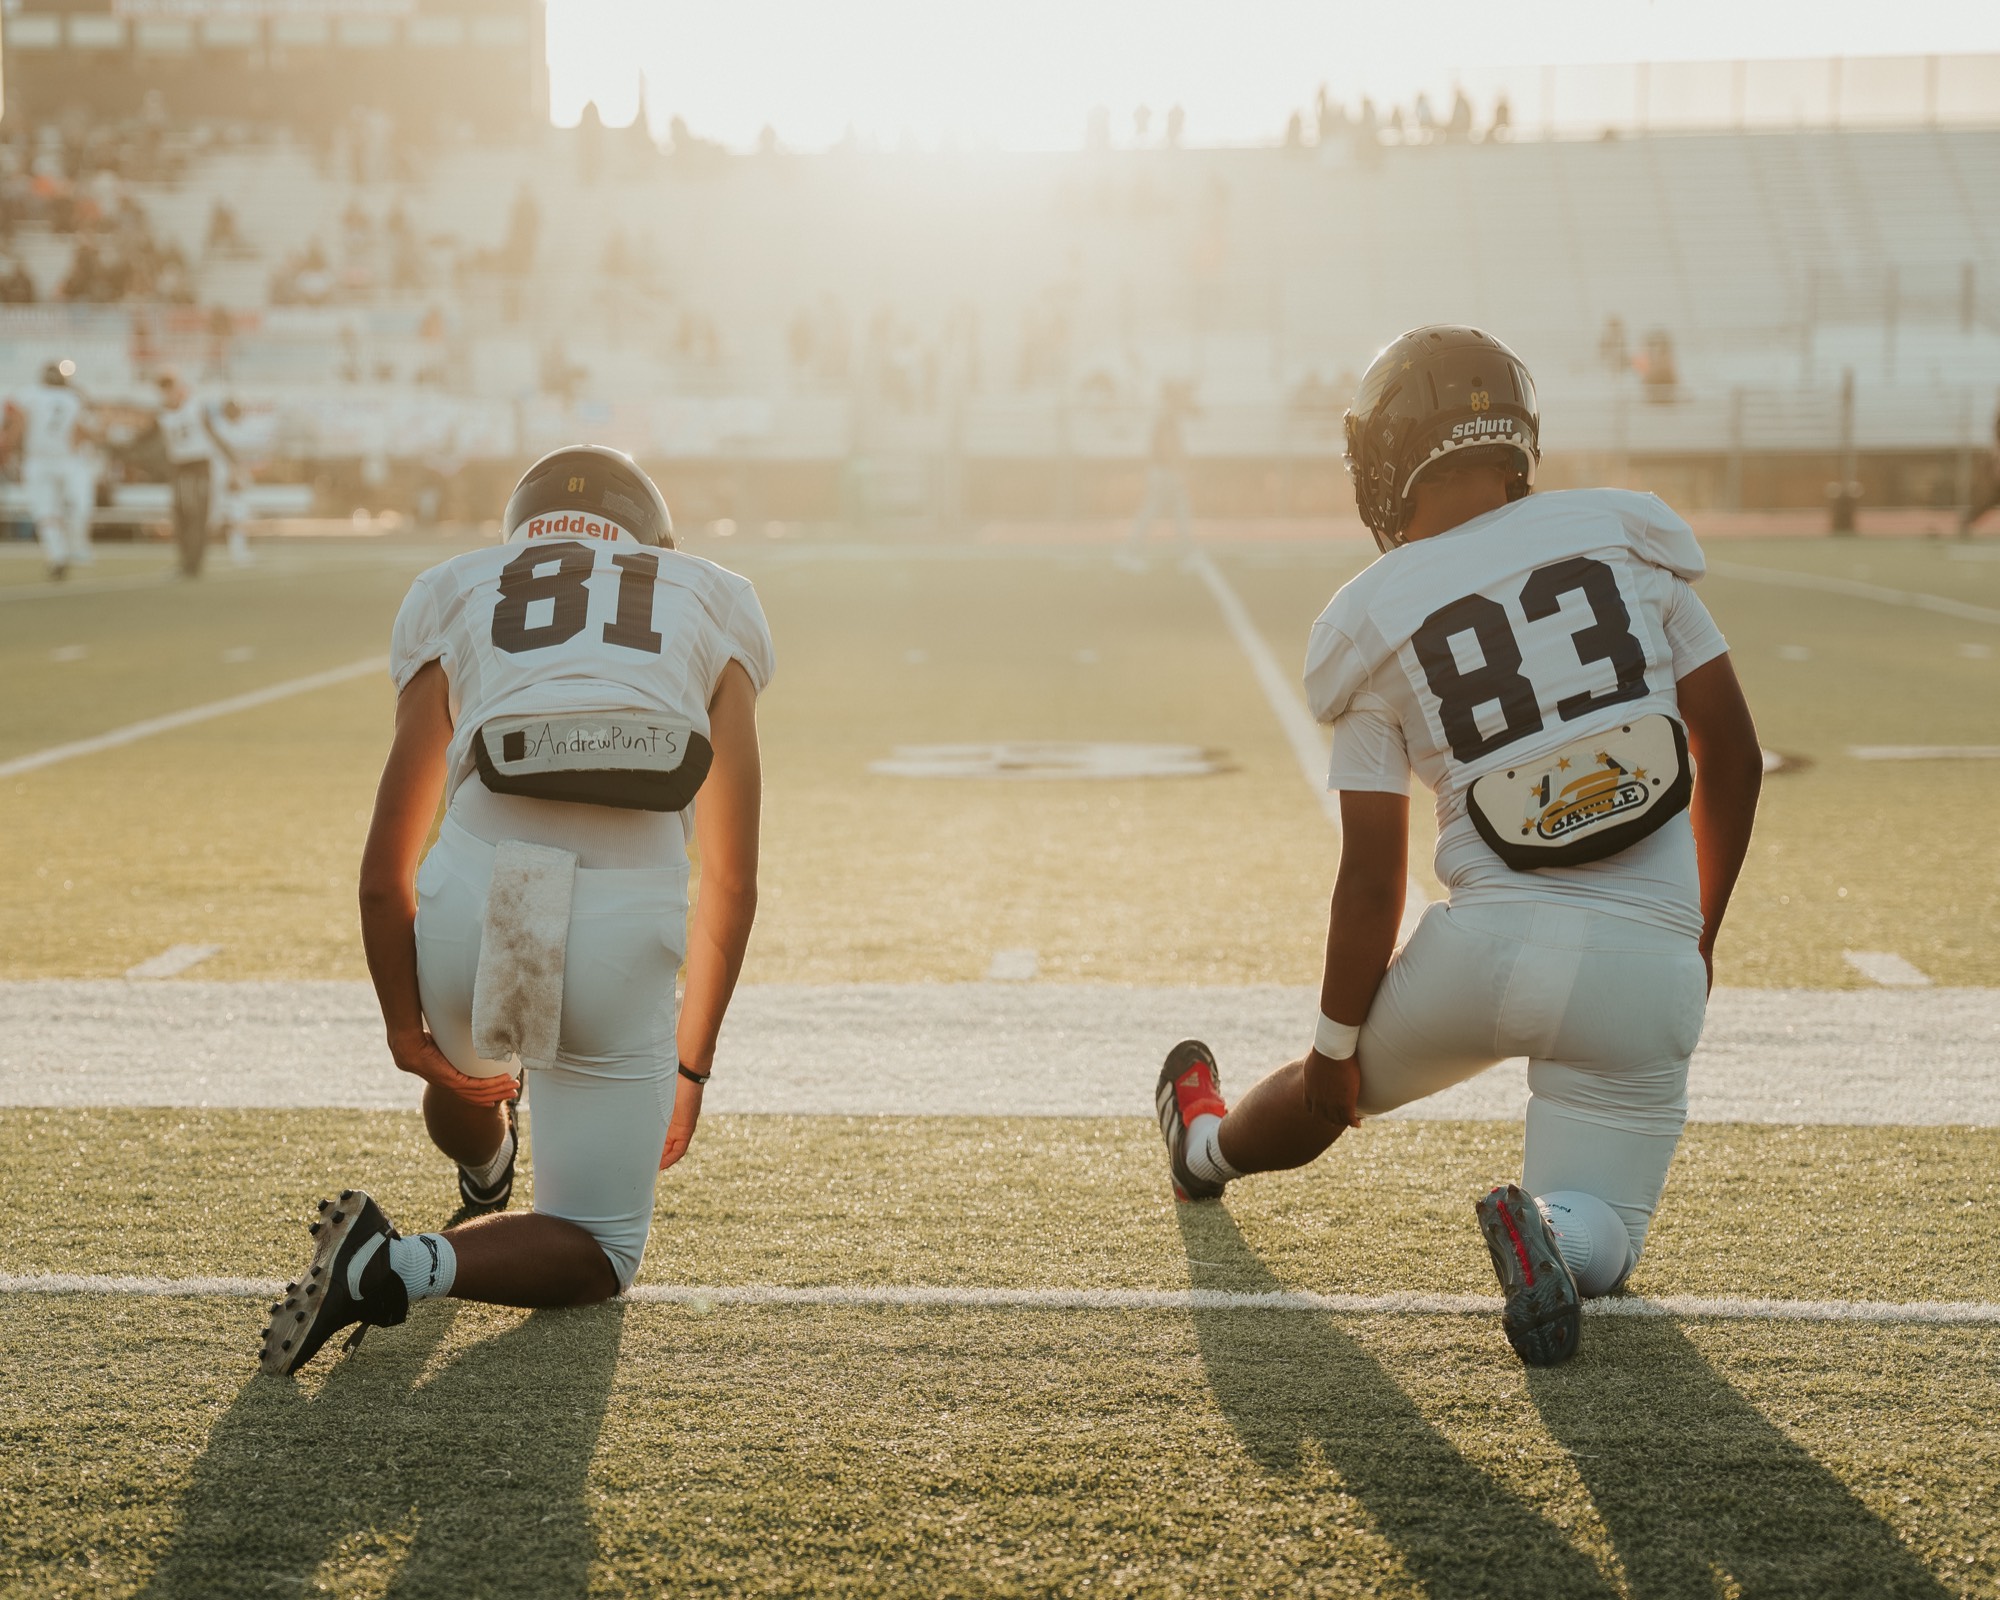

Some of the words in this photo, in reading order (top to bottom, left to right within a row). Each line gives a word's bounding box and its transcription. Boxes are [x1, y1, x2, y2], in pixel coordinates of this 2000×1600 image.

[1470, 391, 1490, 412] 83
[1451, 416, 1513, 439] schutt
[567, 477, 586, 493] 81
[528, 515, 619, 541] Riddell
[491, 541, 662, 655] 81
[1411, 556, 1650, 764] 83
